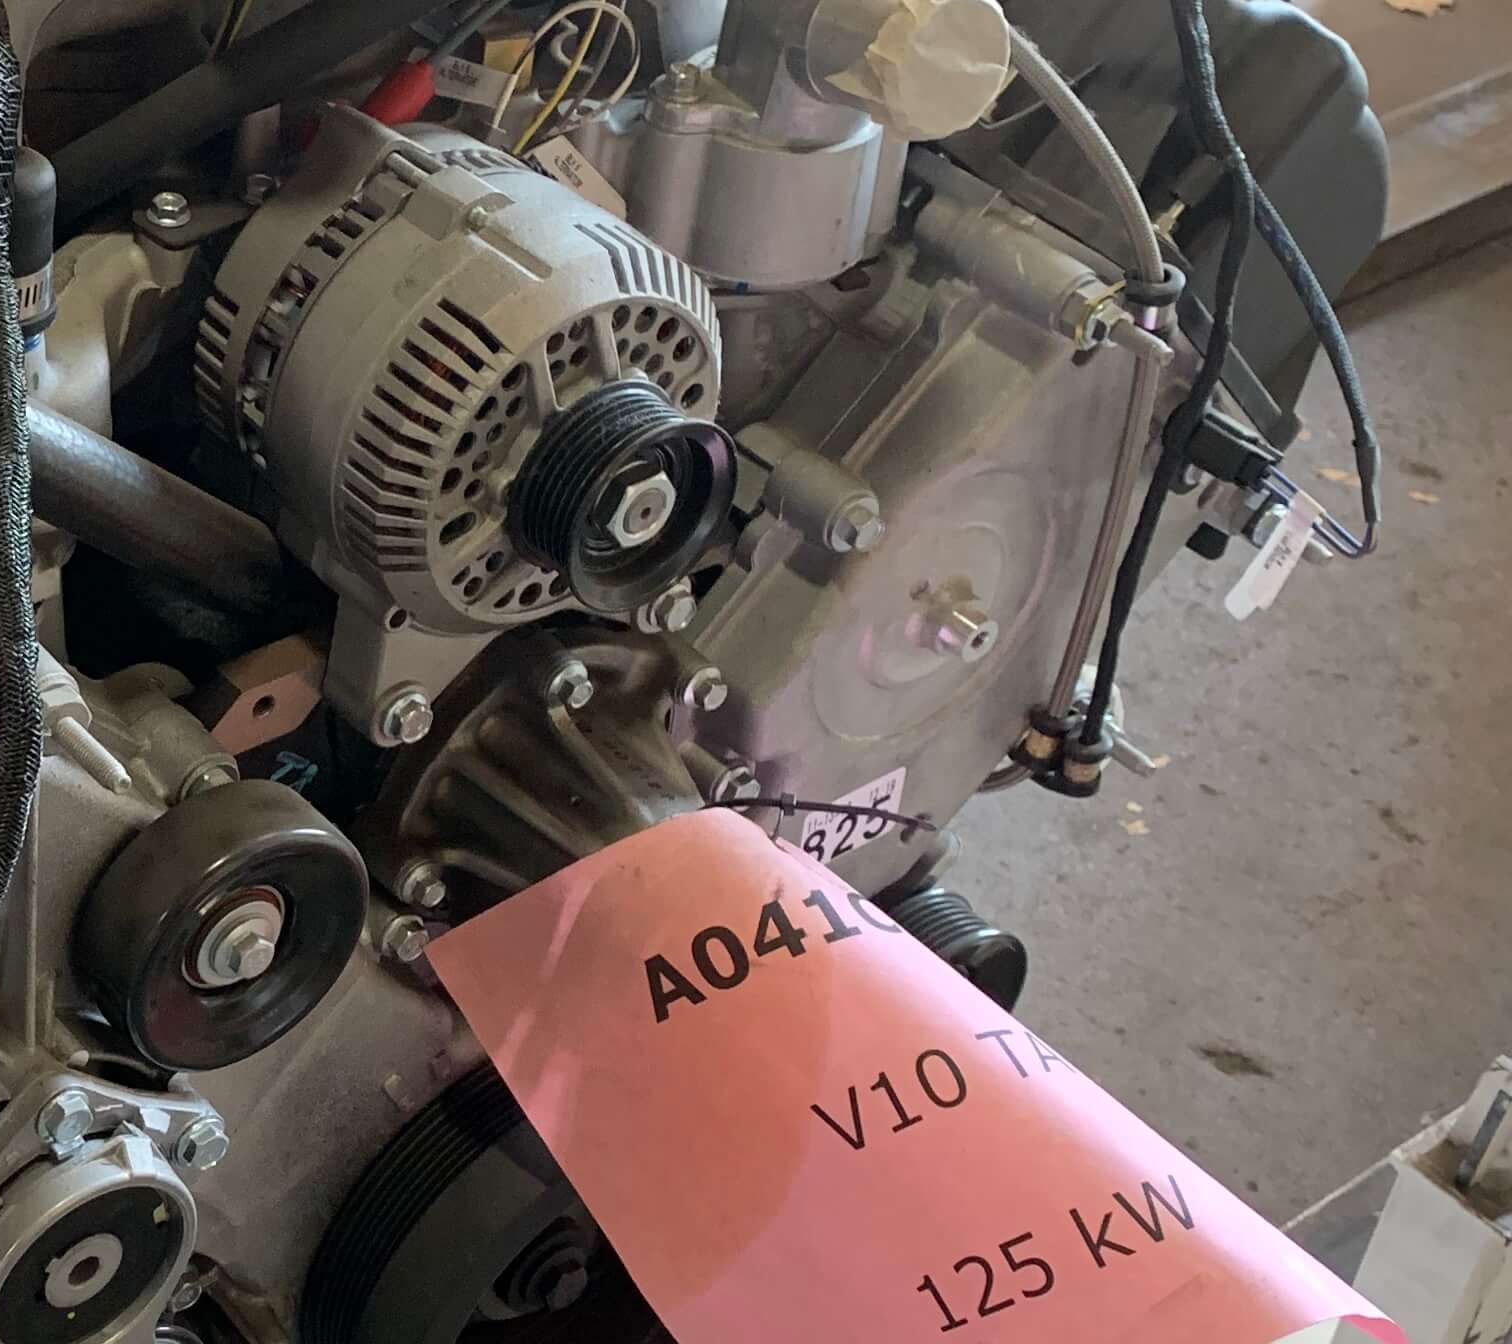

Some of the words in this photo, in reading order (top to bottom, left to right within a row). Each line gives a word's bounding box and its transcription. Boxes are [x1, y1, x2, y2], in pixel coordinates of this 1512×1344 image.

[809, 1048, 968, 1151] V10
[916, 1231, 1056, 1333] 125
[1068, 1174, 1196, 1269] kW
